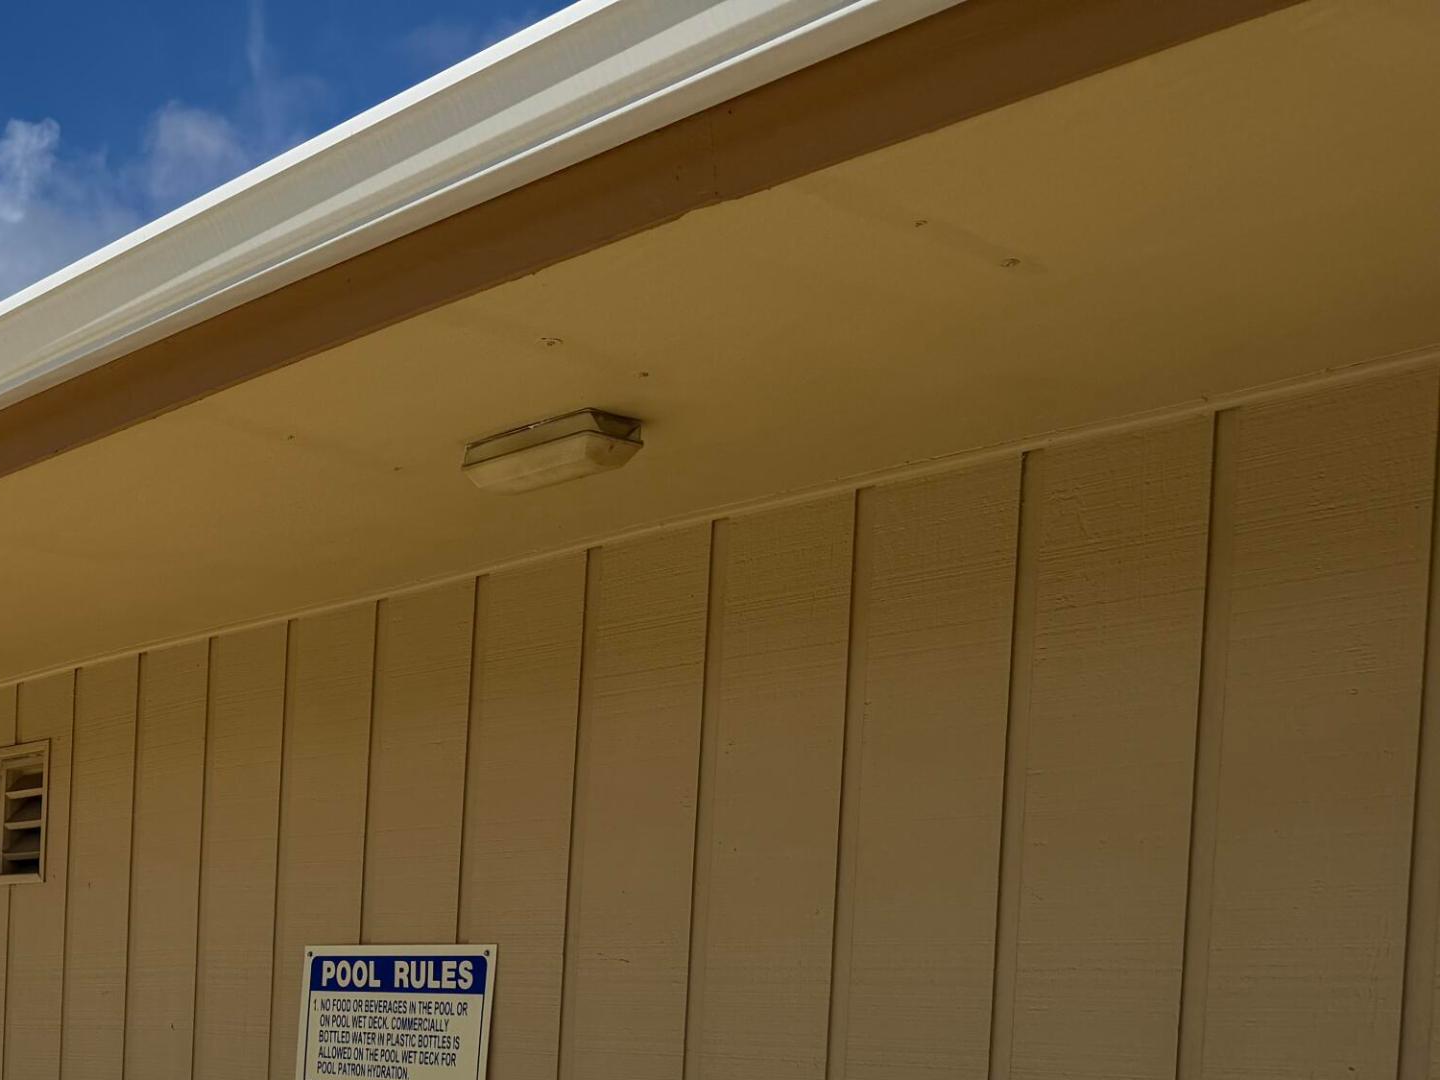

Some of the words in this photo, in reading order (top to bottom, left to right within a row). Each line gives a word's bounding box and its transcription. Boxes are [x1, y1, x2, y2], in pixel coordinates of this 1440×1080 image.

[321, 960, 381, 988] POOL
[394, 960, 474, 990] RULES
[320, 999, 330, 1011] NO
[332, 999, 351, 1012] FOOD
[353, 1000, 362, 1012] OR
[365, 1000, 407, 1014] BEVERAGES
[409, 1001, 416, 1014] IN
[418, 1001, 432, 1014] THE
[434, 1002, 454, 1016] POOL
[457, 1002, 468, 1016] OR
[320, 1014, 330, 1027] ON
[332, 1014, 350, 1027] POOL
[352, 1016, 367, 1028] WET
[369, 1016, 389, 1029] DECK.
[392, 1017, 449, 1032] COMMERCIALLY
[319, 1030, 350, 1043] BOTTLED
[352, 1032, 376, 1045] WATER
[378, 1033, 384, 1045] IN
[387, 1033, 416, 1048] PLASTIC
[418, 1035, 451, 1049] BOTTLES
[453, 1035, 459, 1049] IS
[318, 1046, 351, 1059] ALLOWED
[354, 1047, 363, 1060] ON
[366, 1048, 378, 1061] THE
[380, 1049, 400, 1063] POOL
[402, 1050, 417, 1064] WET
[419, 1051, 439, 1066] DECK
[441, 1052, 456, 1067] FOR
[317, 1061, 336, 1074] POOL
[338, 1063, 365, 1076] PATRON
[367, 1065, 409, 1080] HYDRATION.
